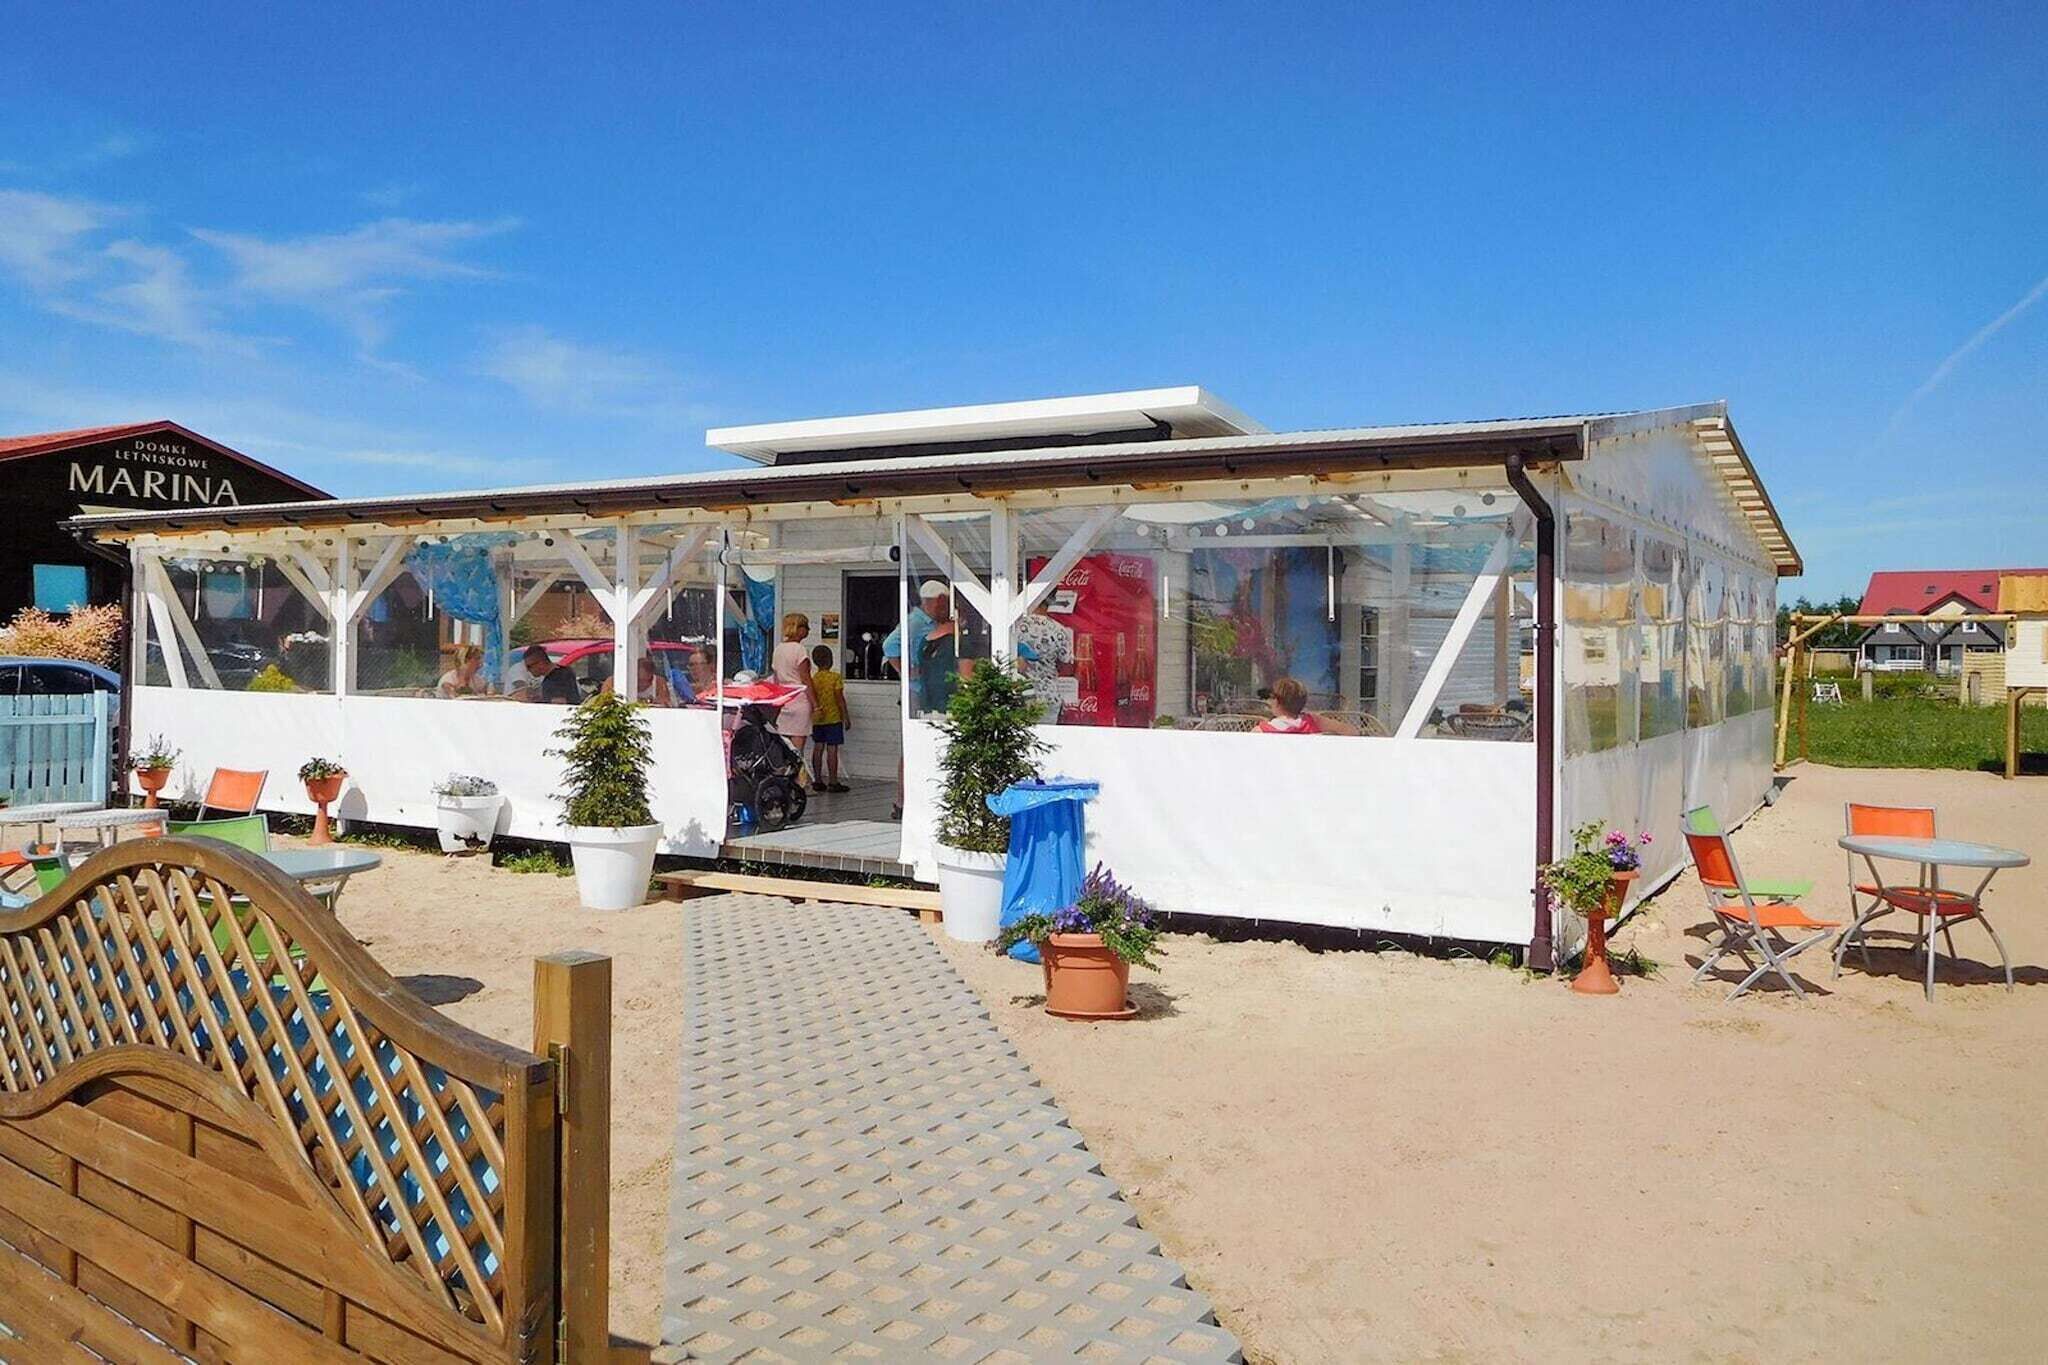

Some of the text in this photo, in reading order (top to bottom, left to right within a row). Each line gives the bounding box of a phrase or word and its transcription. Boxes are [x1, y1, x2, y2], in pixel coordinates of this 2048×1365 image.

[135, 440, 186, 455] DOMKI
[115, 450, 208, 469] LETNISKOWE
[68, 462, 239, 506] MARINA
